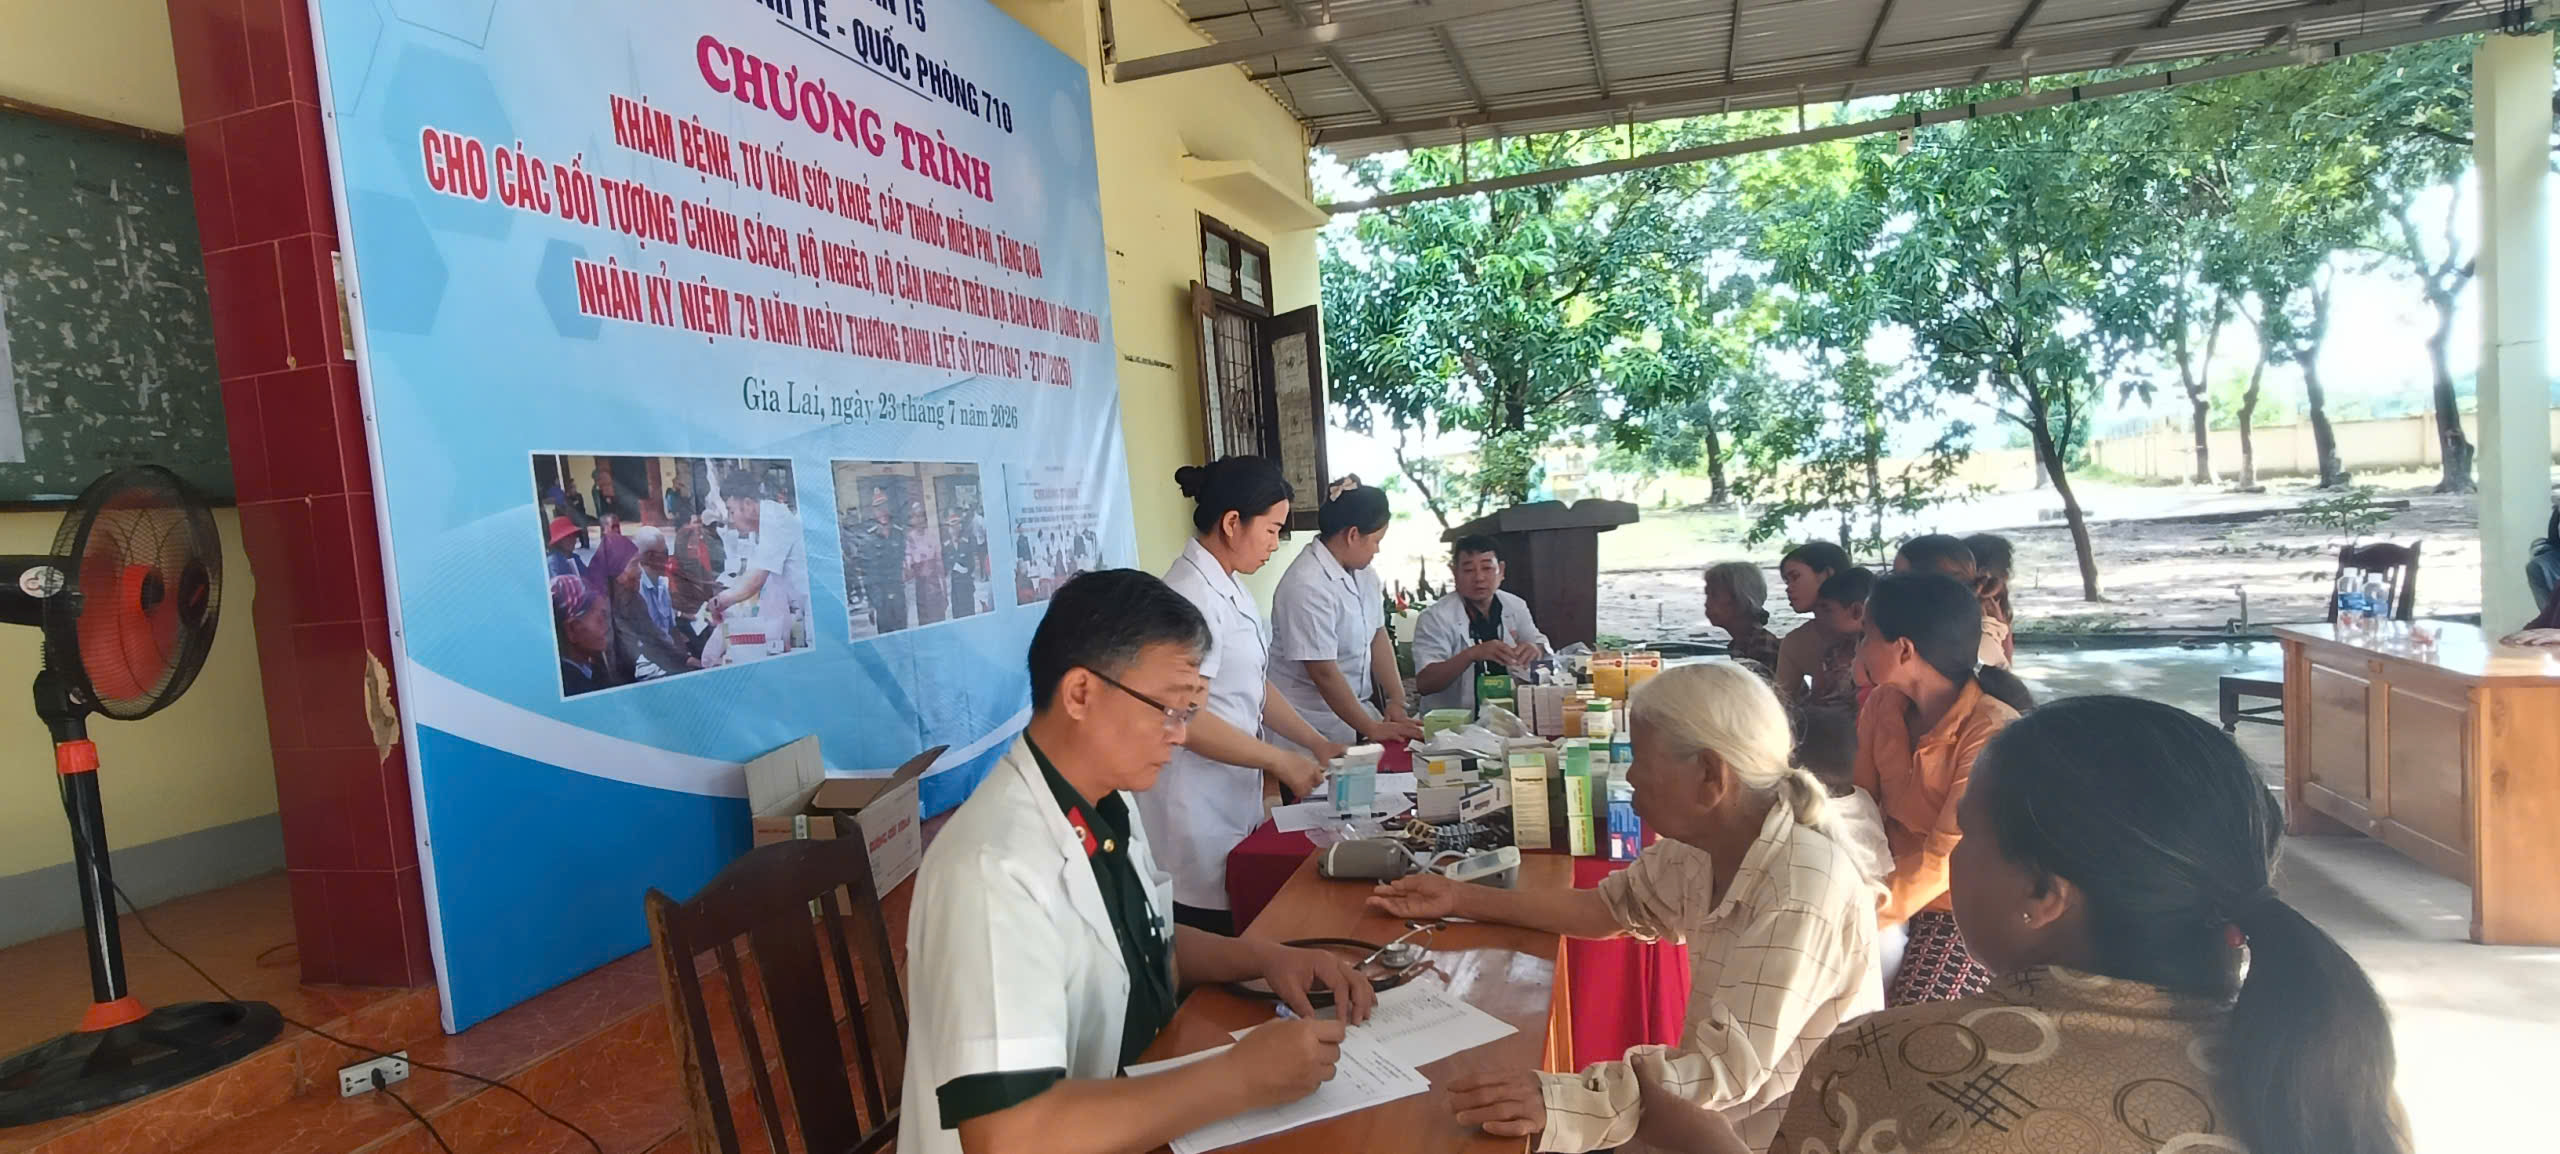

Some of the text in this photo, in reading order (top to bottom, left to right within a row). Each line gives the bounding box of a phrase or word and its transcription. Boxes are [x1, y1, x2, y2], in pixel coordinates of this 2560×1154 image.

[697, 35, 993, 202] CHƯƠNG TRÌNH
[852, 18, 910, 80] QUỐC
[916, 52, 979, 117] PHÒNG
[982, 90, 1013, 134] 710
[422, 128, 488, 200] CHO
[495, 141, 551, 214] CÁC
[553, 153, 599, 227] ĐỐI
[600, 178, 678, 249] TƯỢNG
[681, 197, 742, 260] CHÍNH
[743, 212, 797, 278] SÁCH,
[797, 227, 820, 288] HỘ
[822, 240, 875, 297] NGHÈO,
[875, 250, 894, 304] HỘ
[896, 256, 923, 309] CẬN
[923, 266, 963, 312] NGHÈO
[962, 275, 990, 320] TRÊN
[990, 287, 1009, 329] ĐỊA
[1008, 286, 1029, 328] BÀN
[1028, 296, 1050, 331] ĐƠN
[609, 94, 677, 163] KHÁM
[678, 114, 739, 189] BỆNH,
[739, 141, 763, 191] TƯ
[765, 141, 801, 203] VẤN
[802, 160, 834, 214] SỨC
[835, 173, 879, 232] KHOẺ,
[879, 182, 904, 235] CẤP
[906, 198, 946, 248] THUỐC
[946, 208, 975, 258] MIỄN
[996, 230, 1023, 277] TẶNG
[574, 256, 643, 322] NHÂN
[645, 260, 674, 327] KỶ
[678, 276, 732, 344] NIỆM
[734, 293, 759, 340] 79
[760, 290, 802, 346] NĂM
[803, 301, 844, 353] NGÀY
[846, 315, 901, 362] THƯƠNG
[901, 326, 933, 367] BINH
[932, 326, 957, 377] LIỆT
[743, 376, 1018, 430] Gia Lai, ngày 23 tháng 7 năm 2026
